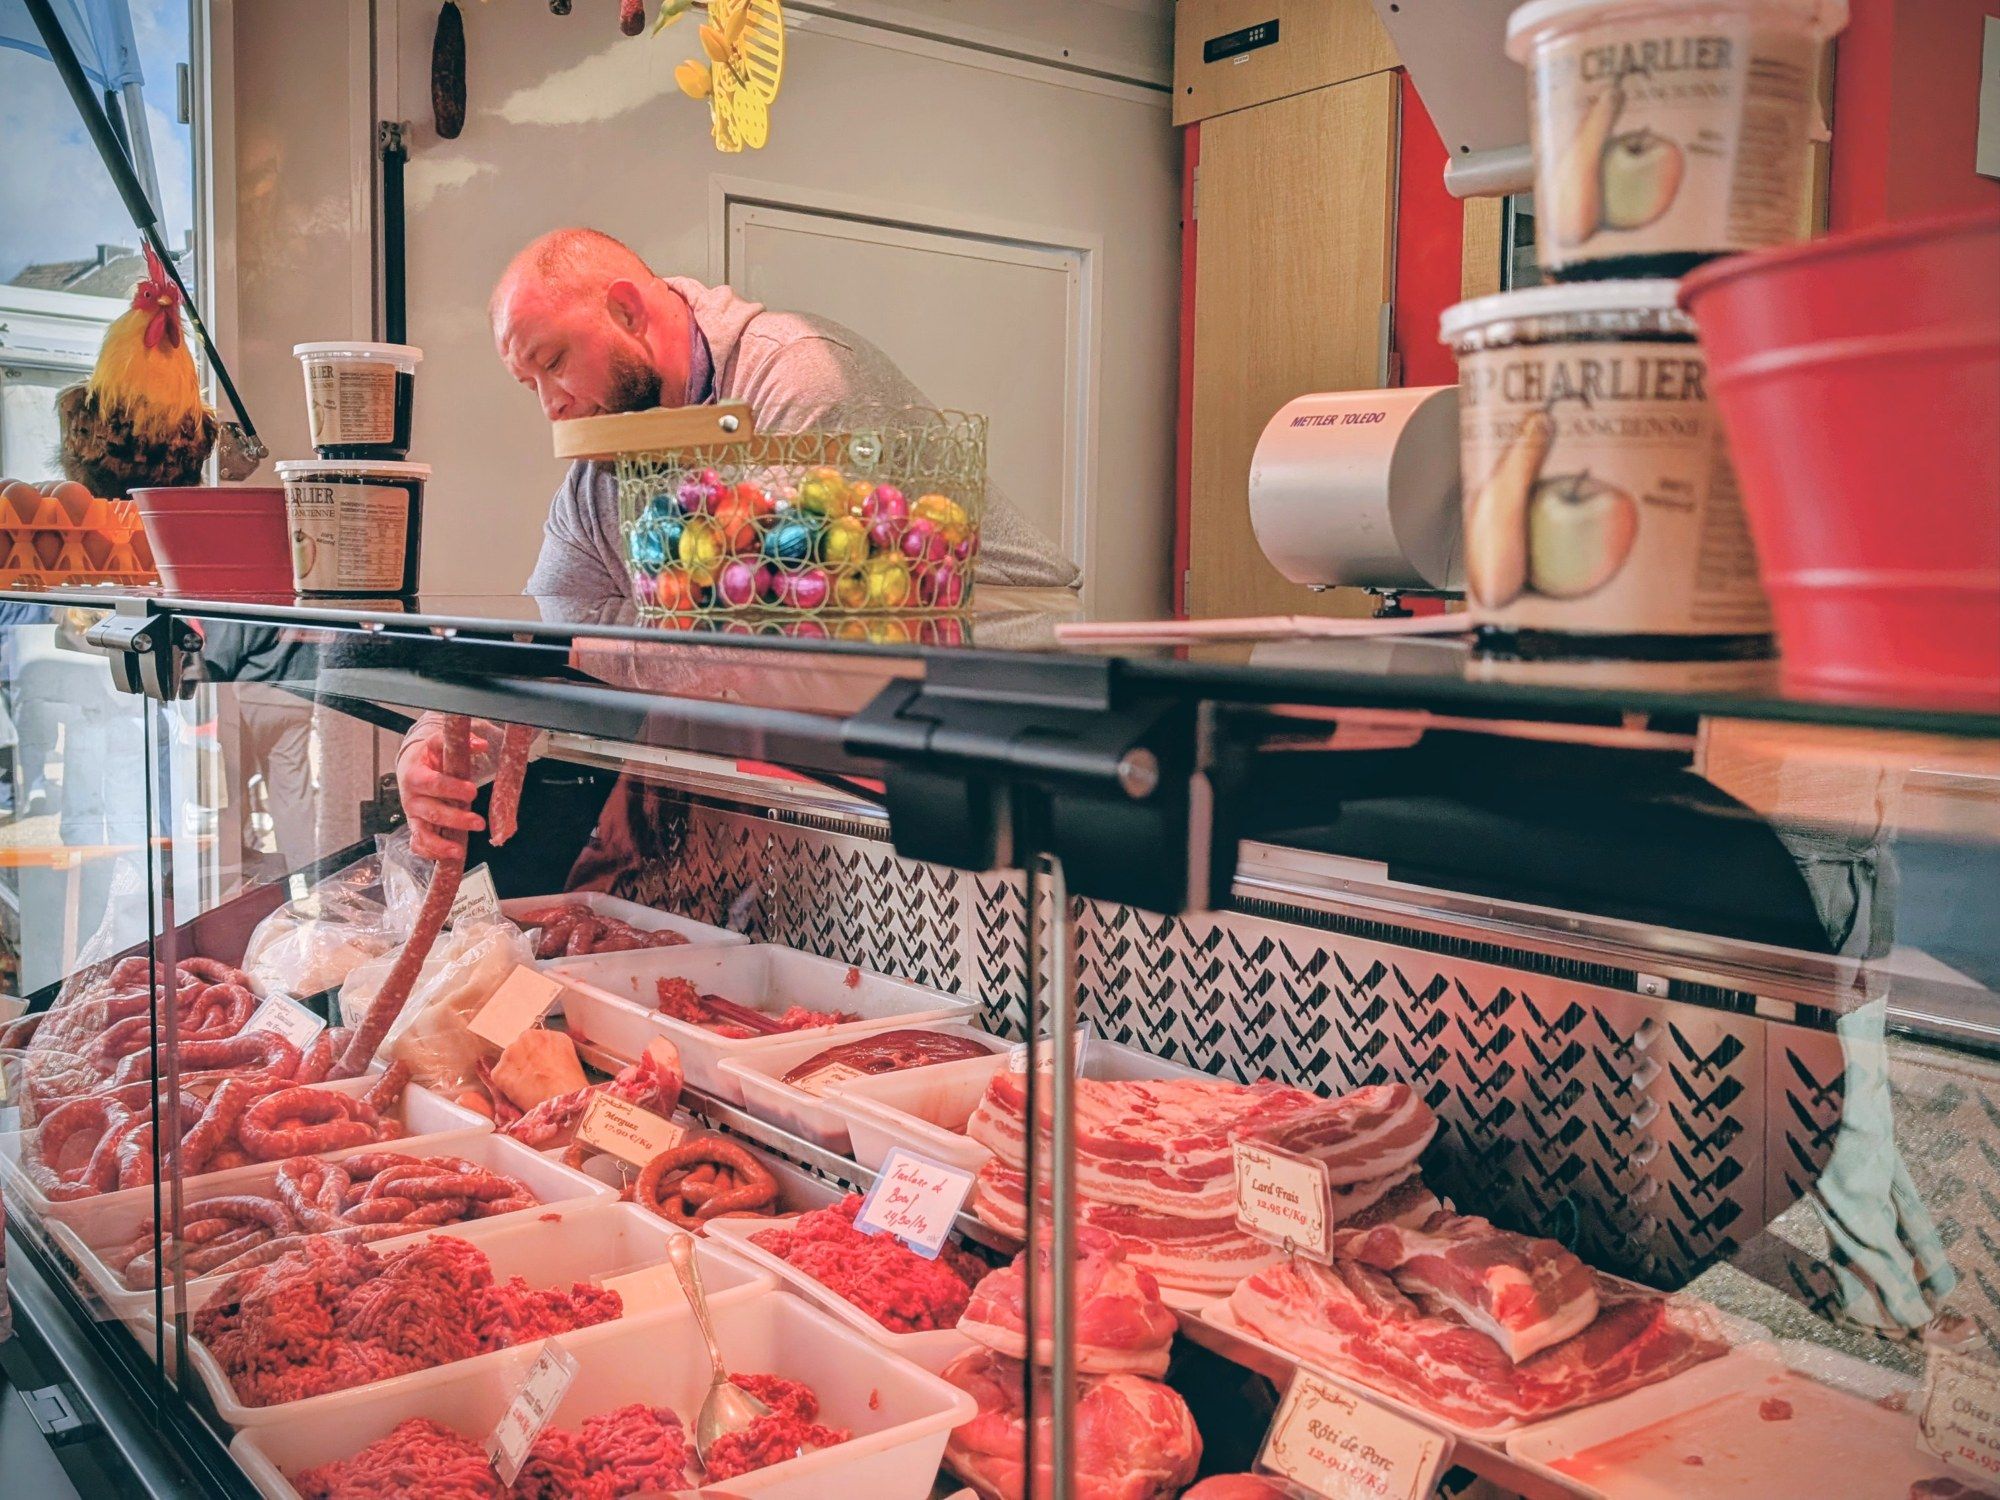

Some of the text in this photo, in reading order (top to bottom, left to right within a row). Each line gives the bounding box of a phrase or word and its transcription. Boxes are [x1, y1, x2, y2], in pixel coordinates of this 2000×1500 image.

[1581, 37, 1732, 81] CHARLIER
[1504, 356, 1708, 403] CHARLIER
[1290, 412, 1386, 428] METTLER TOLEDO
[603, 1111, 639, 1131] Merguez
[1252, 1178, 1299, 1204] Lard Frais
[1283, 1206, 1307, 1225] €/Kg
[1308, 1419, 1394, 1471] Rôti de Porc
